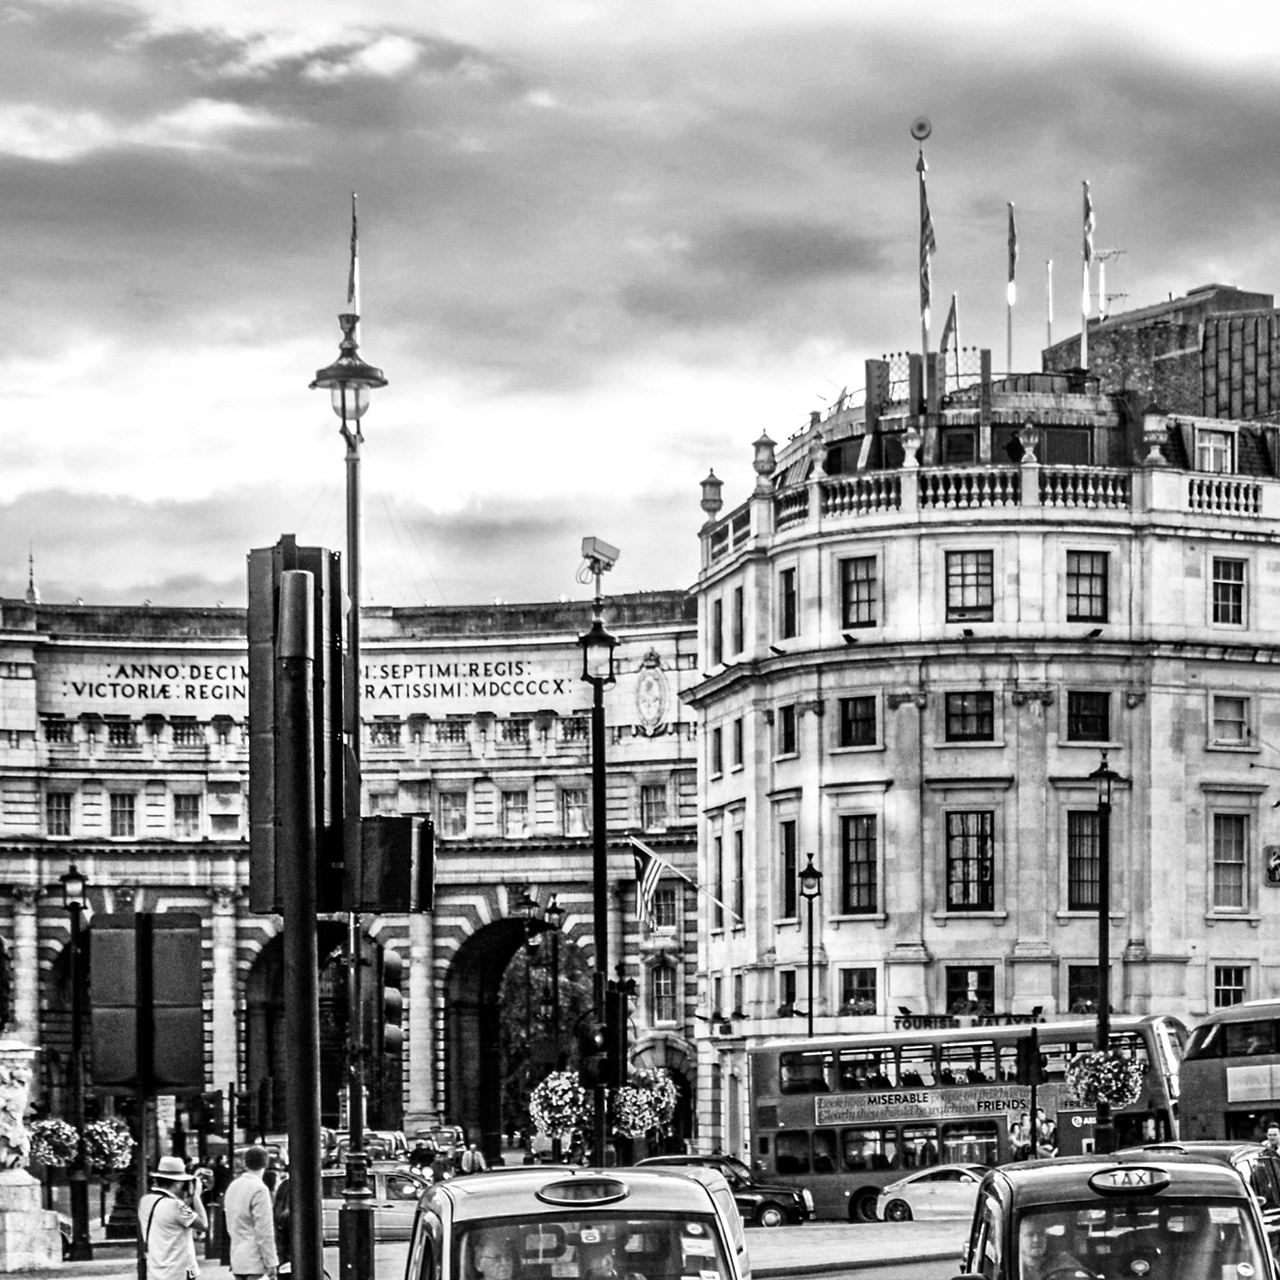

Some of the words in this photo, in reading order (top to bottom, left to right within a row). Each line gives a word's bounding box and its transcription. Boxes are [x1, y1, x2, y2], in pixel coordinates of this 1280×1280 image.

[115, 664, 180, 679] ANNO
[189, 665, 249, 680] DECIM
[185, 684, 246, 700] REGIN
[365, 683, 462, 699] RATISSIMI
[893, 1019, 961, 1030] TOURISM
[867, 1092, 929, 1105] MISERABLE
[1109, 1171, 1154, 1186] TAXI
